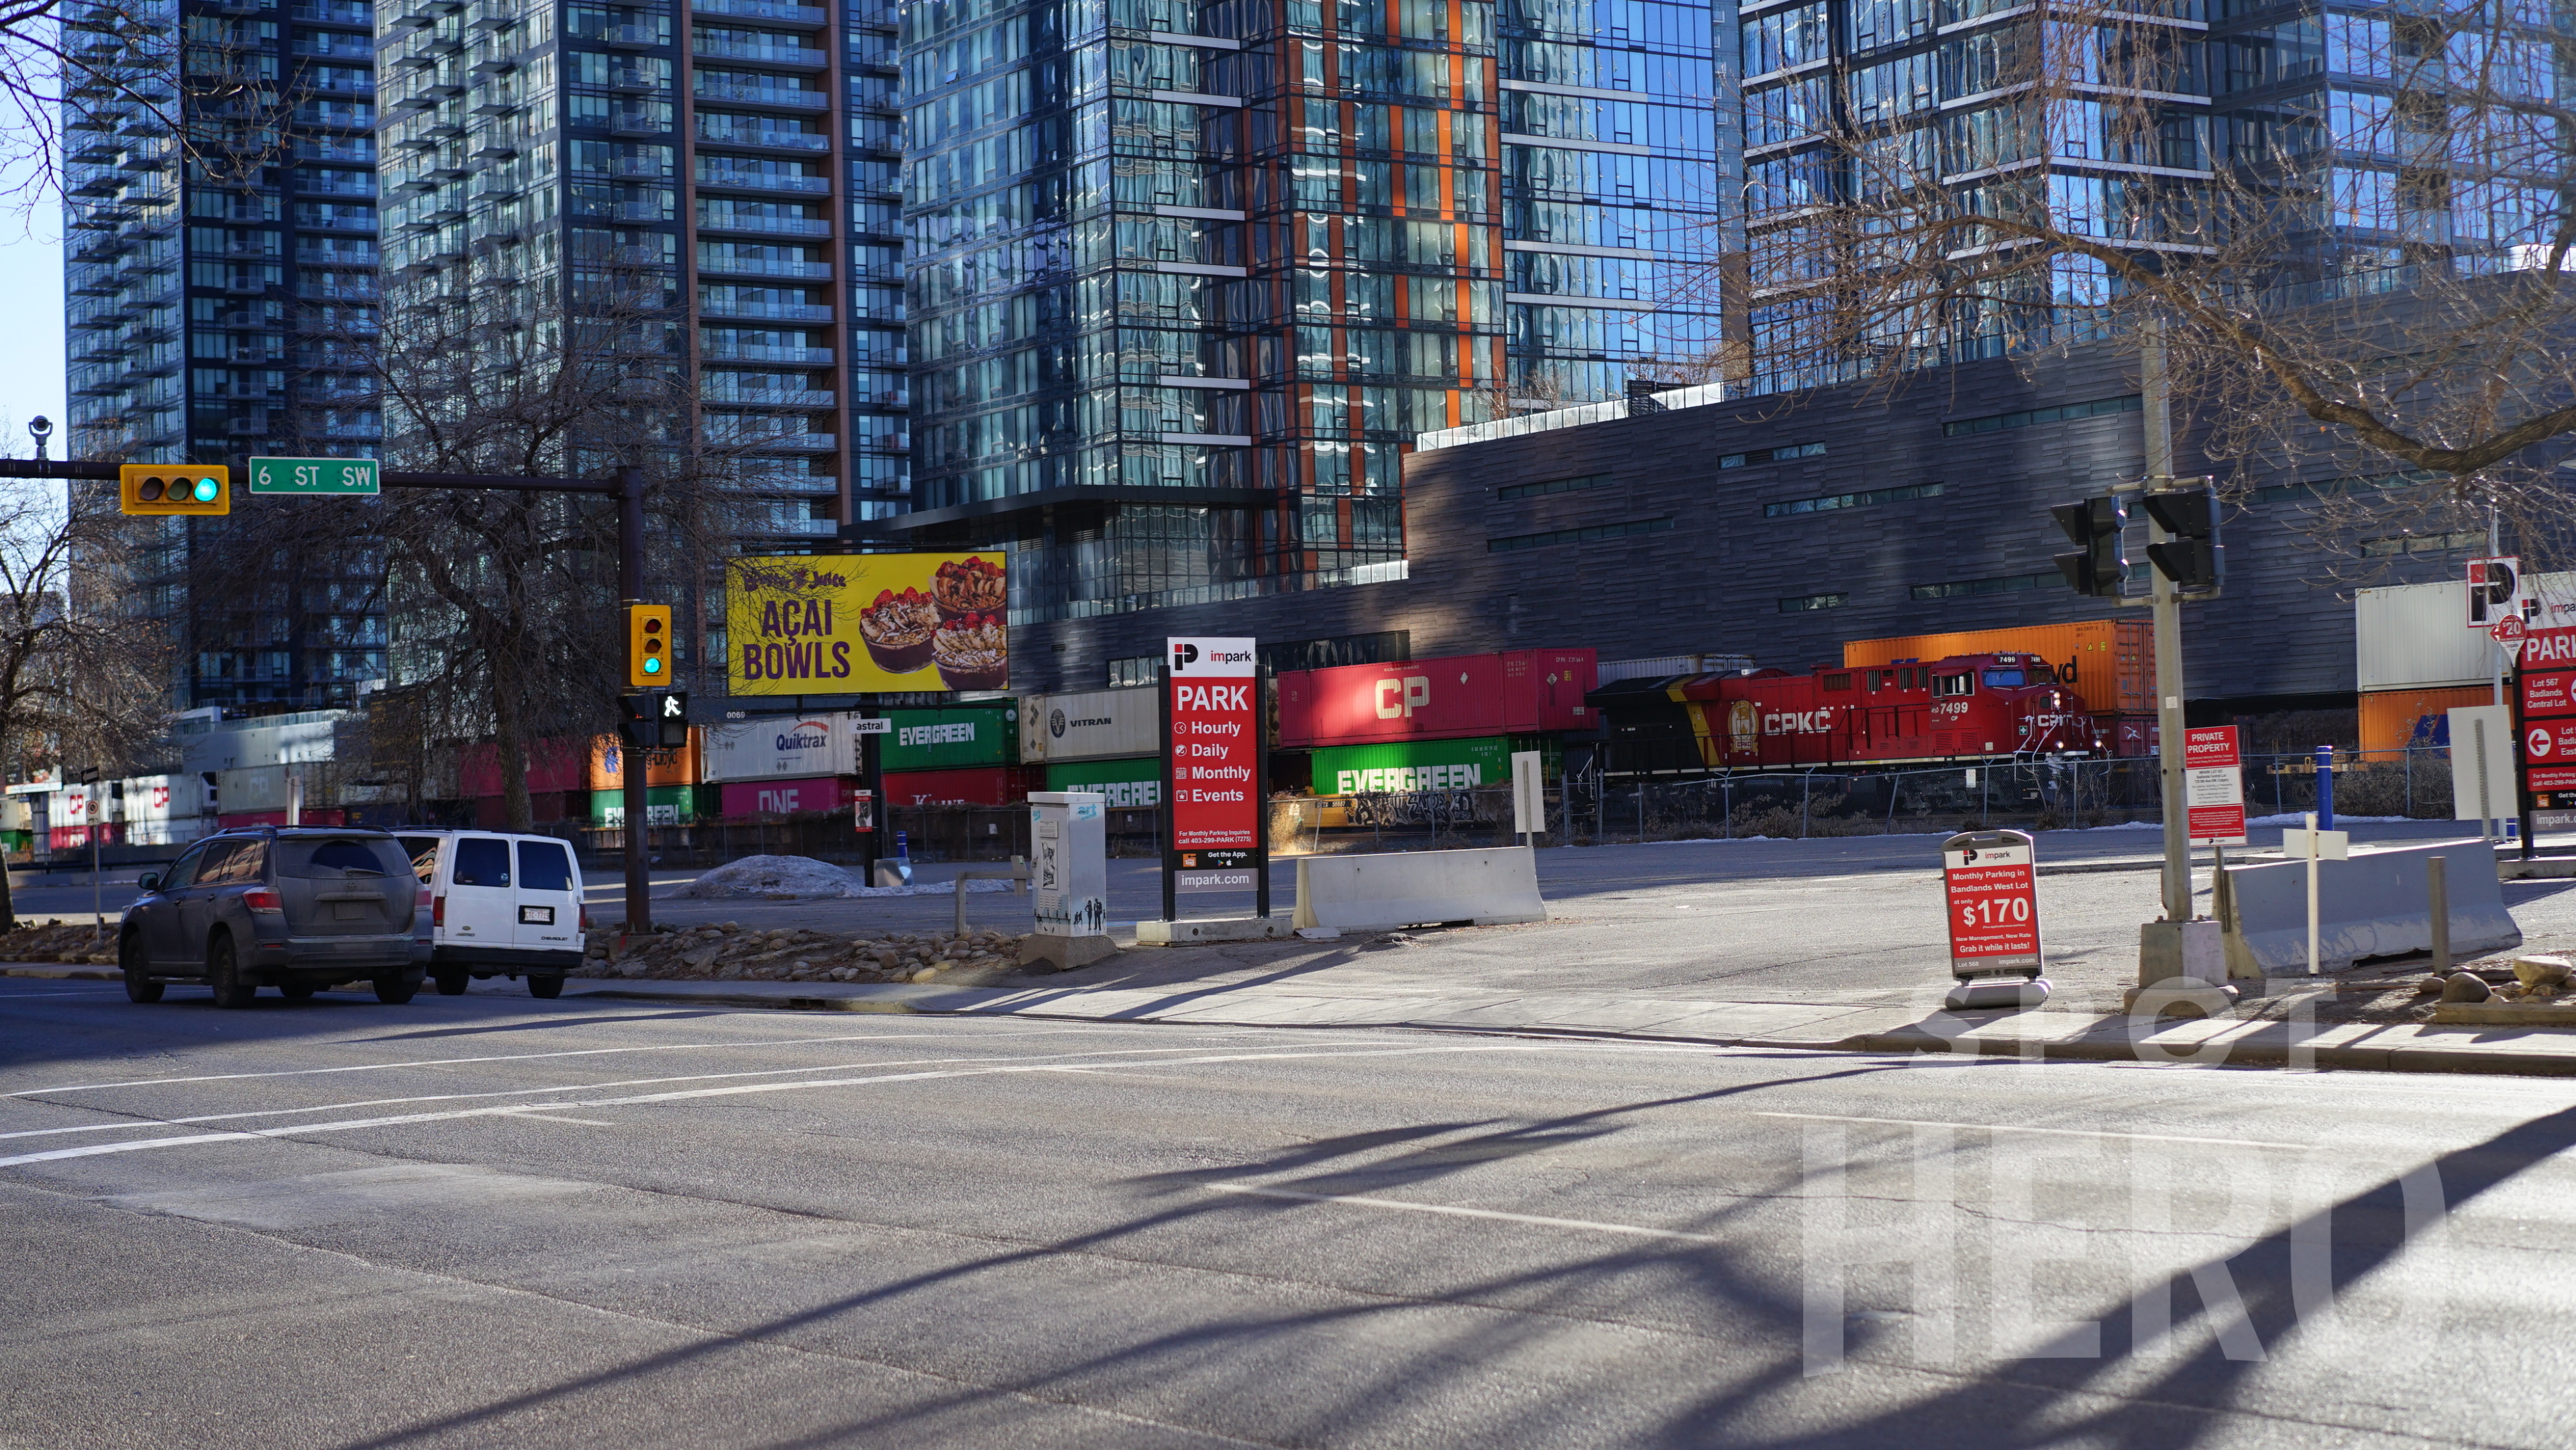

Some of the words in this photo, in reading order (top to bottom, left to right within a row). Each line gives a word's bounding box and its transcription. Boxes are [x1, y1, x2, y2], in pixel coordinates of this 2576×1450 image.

[258, 467, 272, 486] 6
[294, 466, 319, 486] ST
[342, 467, 372, 487] SW
[761, 599, 833, 647] AÇAI
[743, 641, 851, 679] BOWLS
[1211, 650, 1252, 665] impark
[2546, 678, 2559, 686] 567
[1177, 685, 1248, 711] PARK
[1375, 675, 1430, 719] CP
[2529, 689, 2563, 698] Badlands
[1940, 702, 1968, 714] 7499
[2527, 700, 2553, 708] Central
[2555, 699, 2567, 707] Lot
[857, 722, 883, 731] astral
[1070, 718, 1112, 727] VITRAN
[1191, 721, 1241, 737] Hourly
[1764, 710, 1831, 736] CPKC
[900, 722, 975, 746] EVERGREEN
[2191, 732, 2224, 742] PRIVATE
[776, 734, 827, 751] Quiktrax
[2187, 742, 2230, 754] PROPERTY
[1191, 744, 1229, 760] Daily
[1192, 766, 1251, 781] Monthly
[1338, 763, 1481, 795] EVERGREEN
[154, 787, 170, 808] CP
[1193, 789, 1244, 801] Events
[70, 795, 83, 814] CP
[1985, 851, 2010, 860] impark
[1181, 874, 1250, 888] impark.com
[1952, 873, 1984, 881] Monthly
[1986, 871, 2016, 879] Parking
[1951, 884, 1992, 893] Bandlands
[1994, 882, 2014, 890] West
[1963, 897, 2029, 927] $170
[1960, 945, 1977, 953] Grab
[1984, 943, 2003, 951] while
[2010, 942, 2030, 950] lasts!
